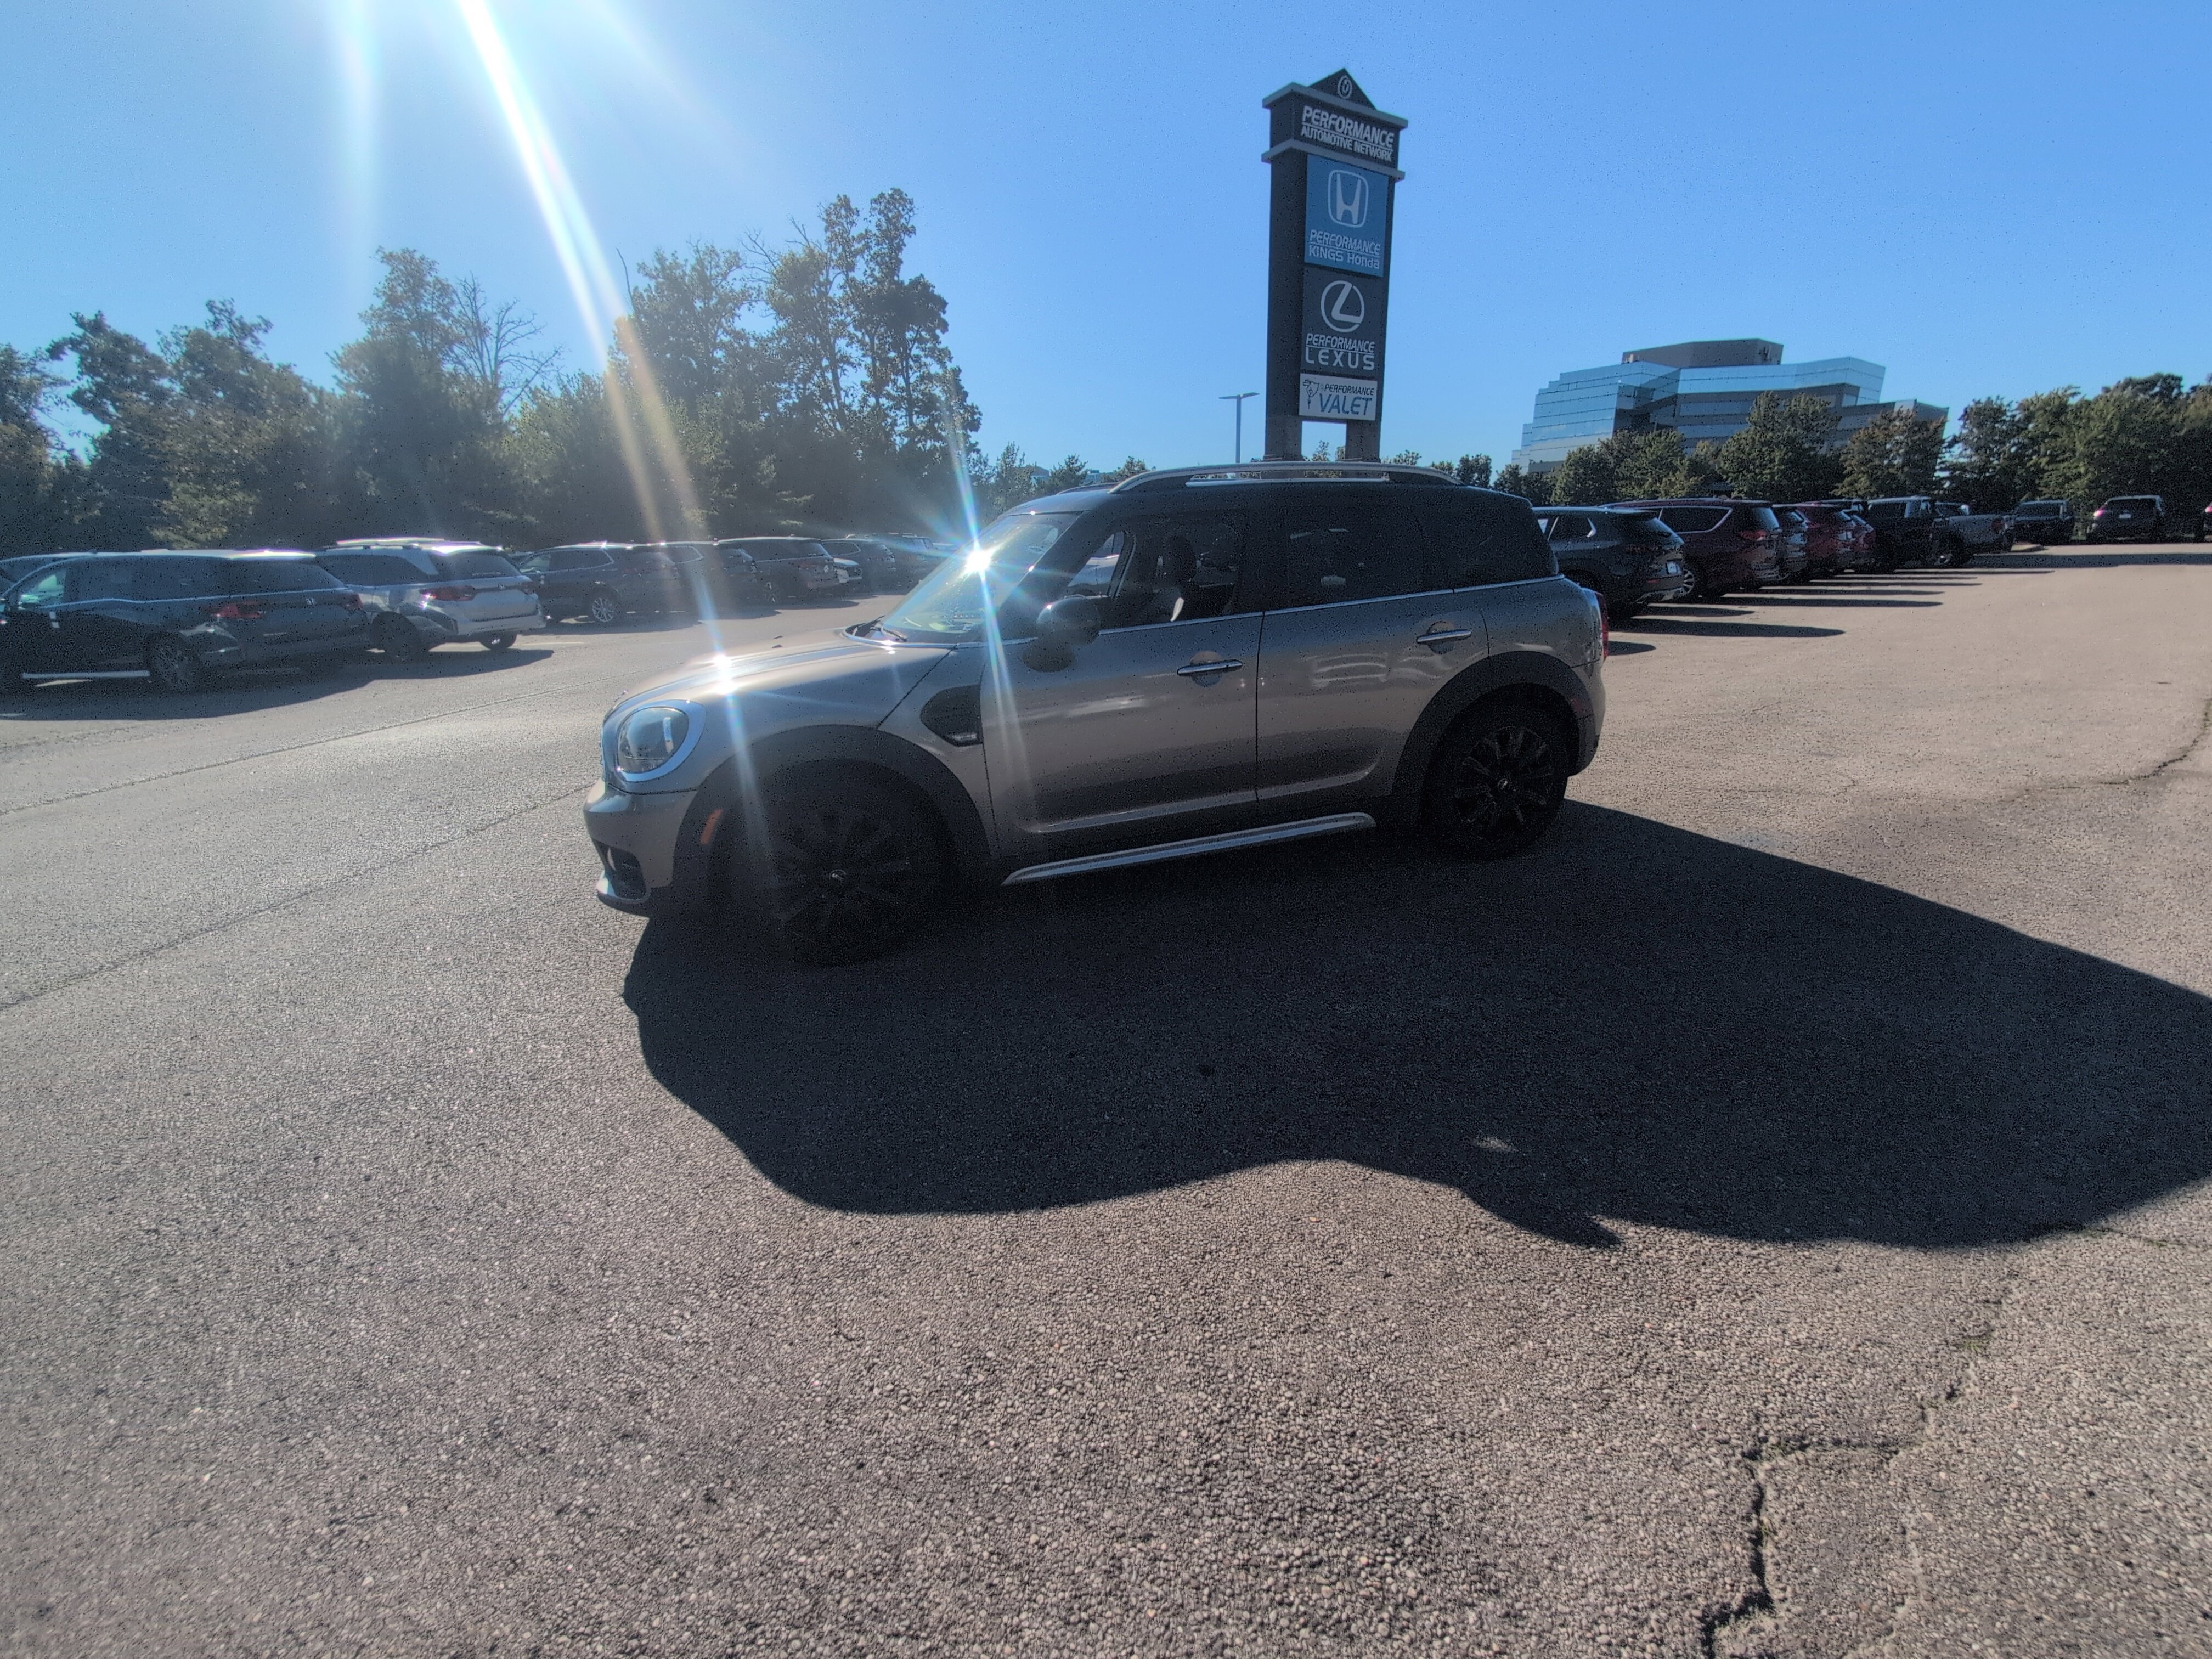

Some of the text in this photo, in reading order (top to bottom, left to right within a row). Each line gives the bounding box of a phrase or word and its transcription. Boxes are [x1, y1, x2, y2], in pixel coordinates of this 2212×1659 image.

[1302, 106, 1395, 148] PERFORMANCE
[1301, 127, 1392, 162] AUTOMOTIVE NETWORK
[1309, 245, 1344, 262] KINGS
[1310, 229, 1381, 256] PERFORMANCE
[1306, 333, 1375, 353] PERFORMANCE
[1305, 348, 1375, 371] LEXUS
[1324, 383, 1374, 396] PERFORMANCE
[1319, 393, 1373, 416] VALET
